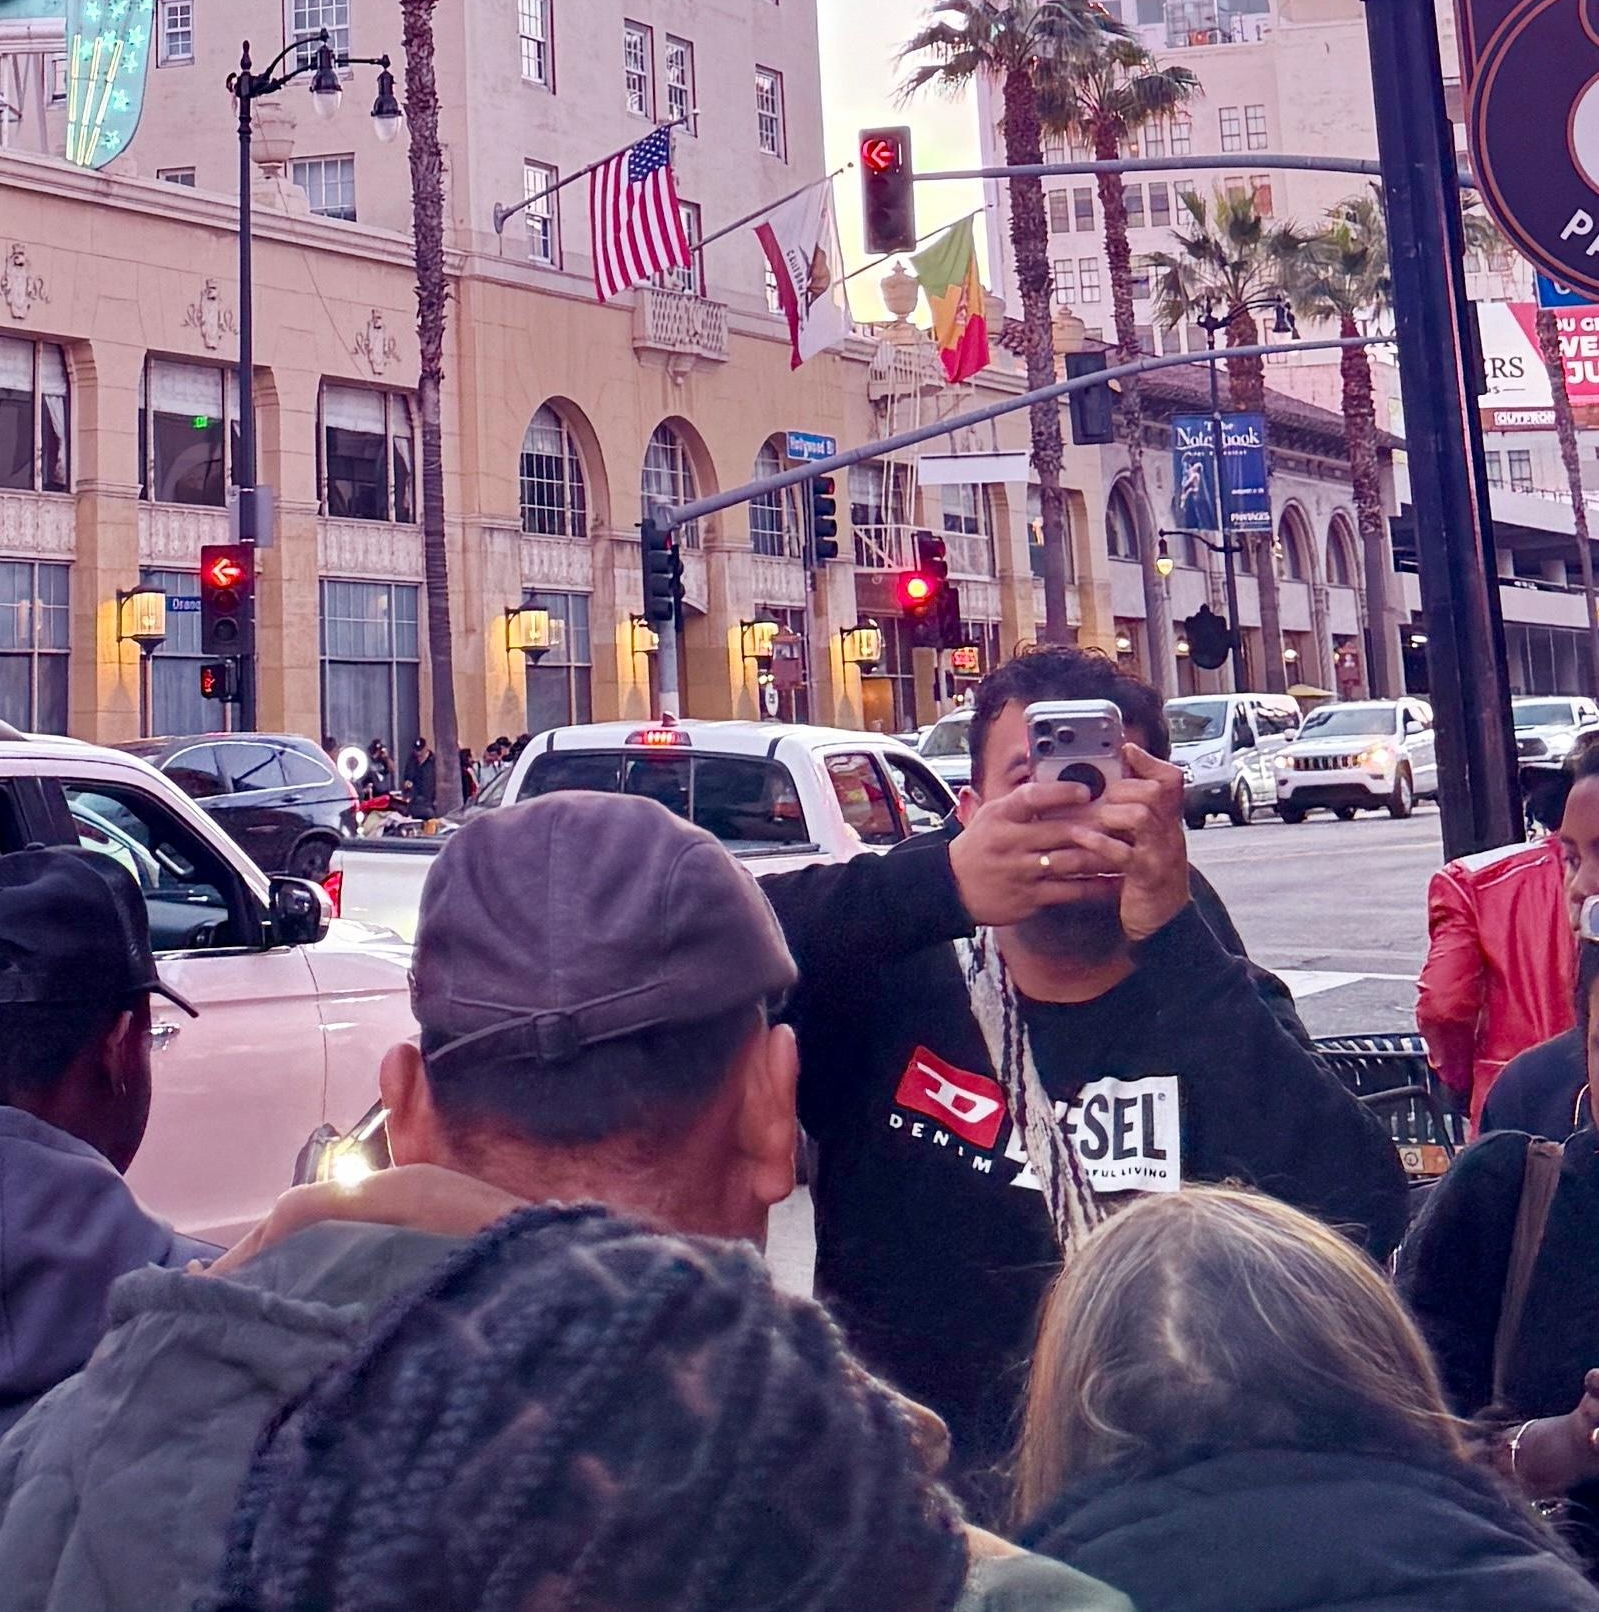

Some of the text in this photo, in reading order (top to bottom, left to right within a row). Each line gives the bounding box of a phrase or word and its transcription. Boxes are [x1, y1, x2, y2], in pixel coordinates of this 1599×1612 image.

[1485, 356, 1524, 378] RS
[888, 1112, 994, 1174] DENIM
[1121, 1166, 1167, 1178] LIVING
